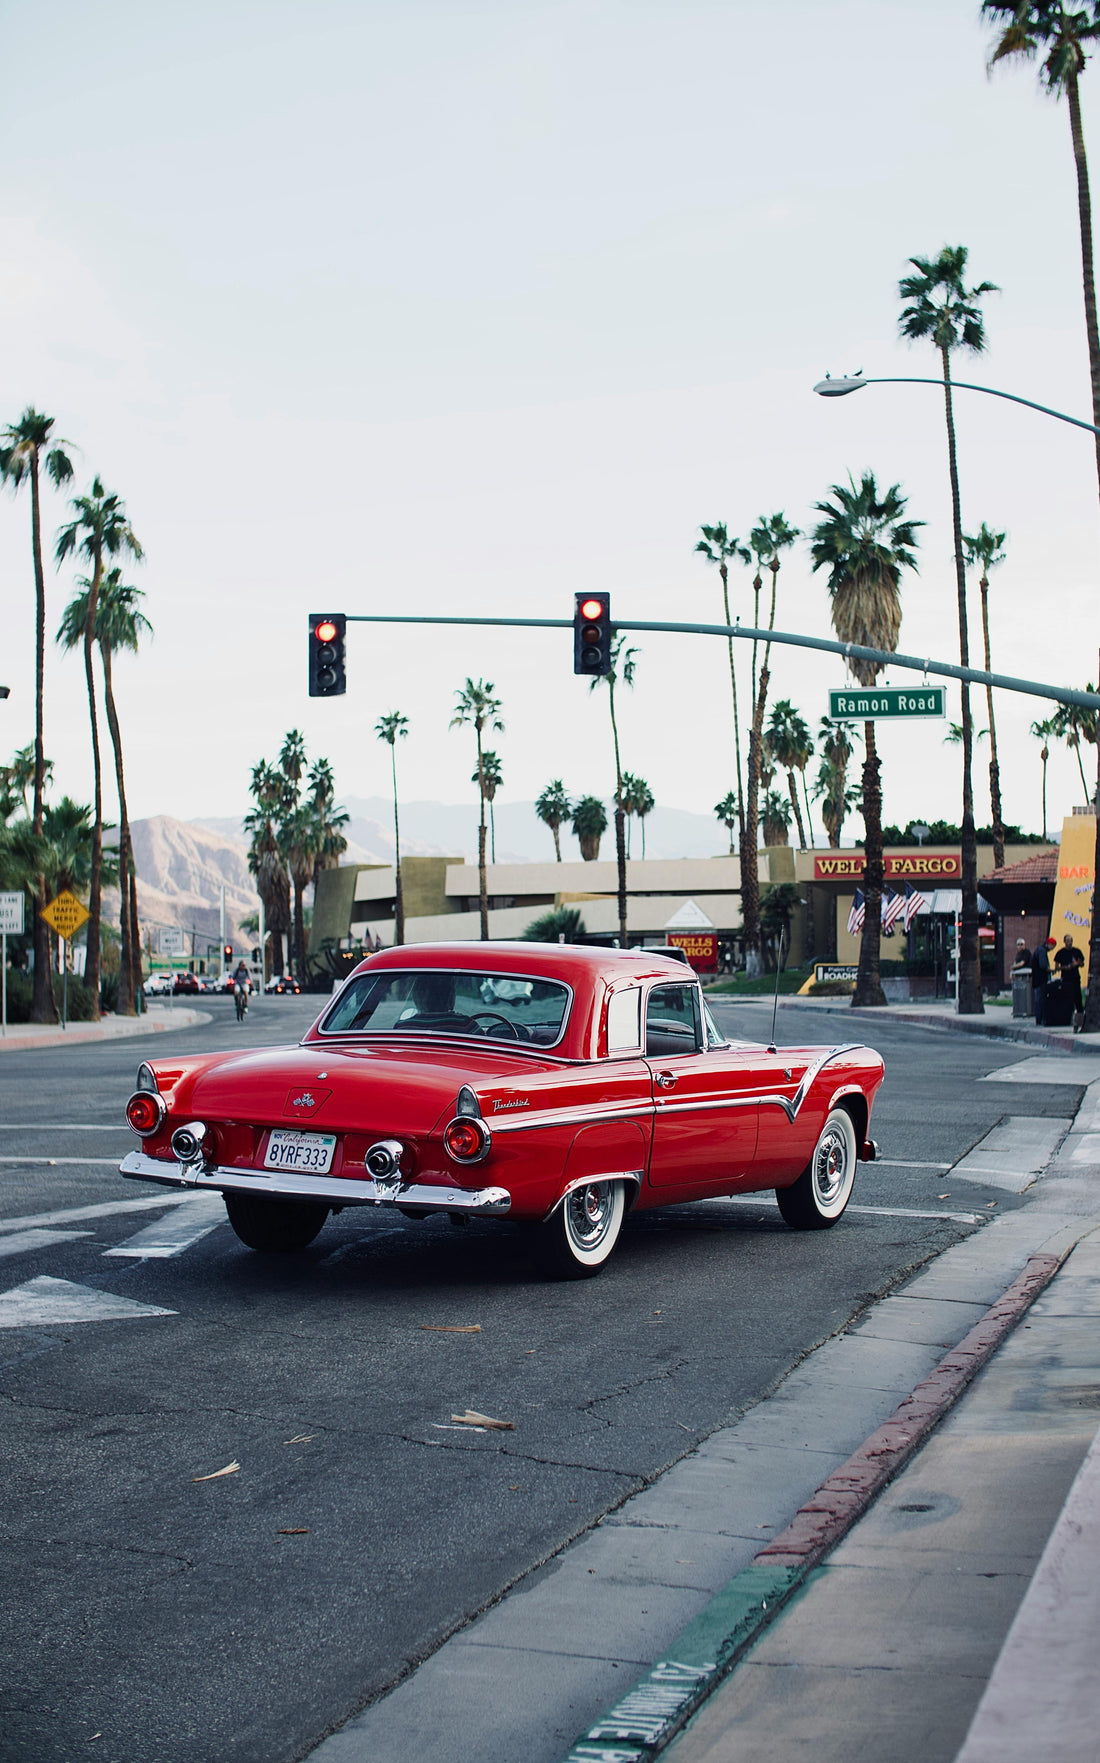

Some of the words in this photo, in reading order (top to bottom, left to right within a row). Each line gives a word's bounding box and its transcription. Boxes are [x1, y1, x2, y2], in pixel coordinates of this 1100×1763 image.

[838, 697, 889, 712] Ramon
[898, 695, 936, 710] Road
[890, 858, 957, 873] FARGO
[1060, 866, 1089, 879] BAR
[671, 938, 713, 947] WELLS
[492, 1098, 530, 1112] Thunderbird
[283, 1132, 323, 1145] California
[269, 1144, 328, 1167] 8YRF333
